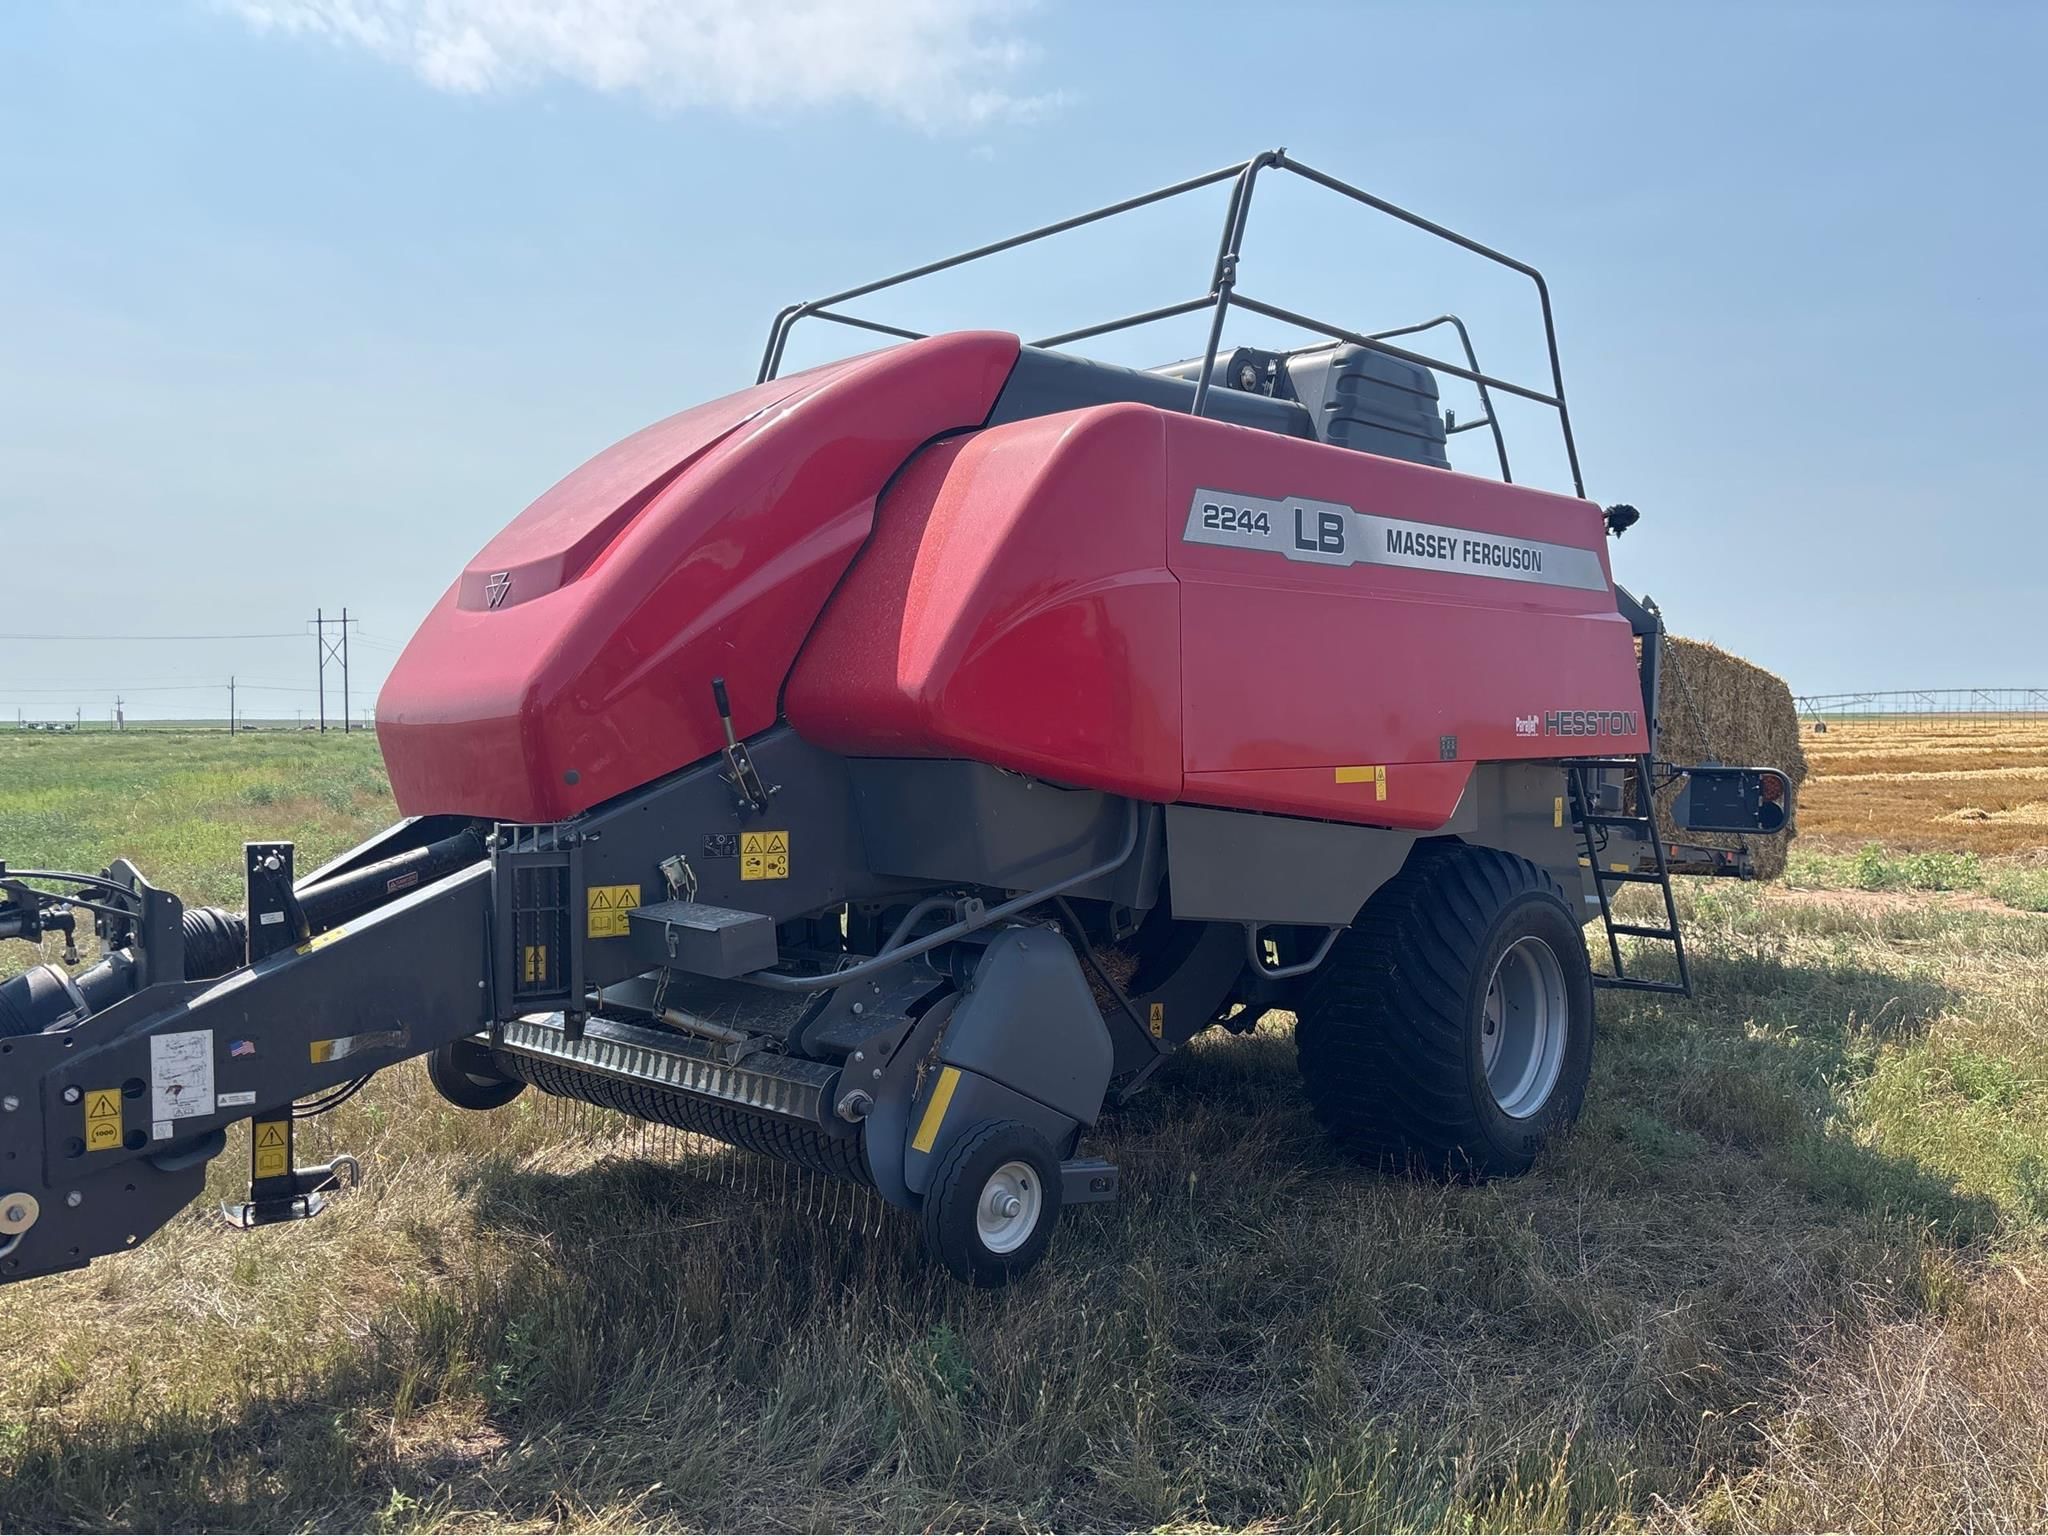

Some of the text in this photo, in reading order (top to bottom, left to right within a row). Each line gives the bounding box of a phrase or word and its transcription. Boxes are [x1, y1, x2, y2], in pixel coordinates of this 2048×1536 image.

[1202, 503, 1271, 536] 2244
[1294, 508, 1346, 555] LB
[1386, 528, 1543, 573] MASSEY FERGUSON
[1544, 710, 1638, 737] HESSTON
[95, 1129, 114, 1137] 1000
